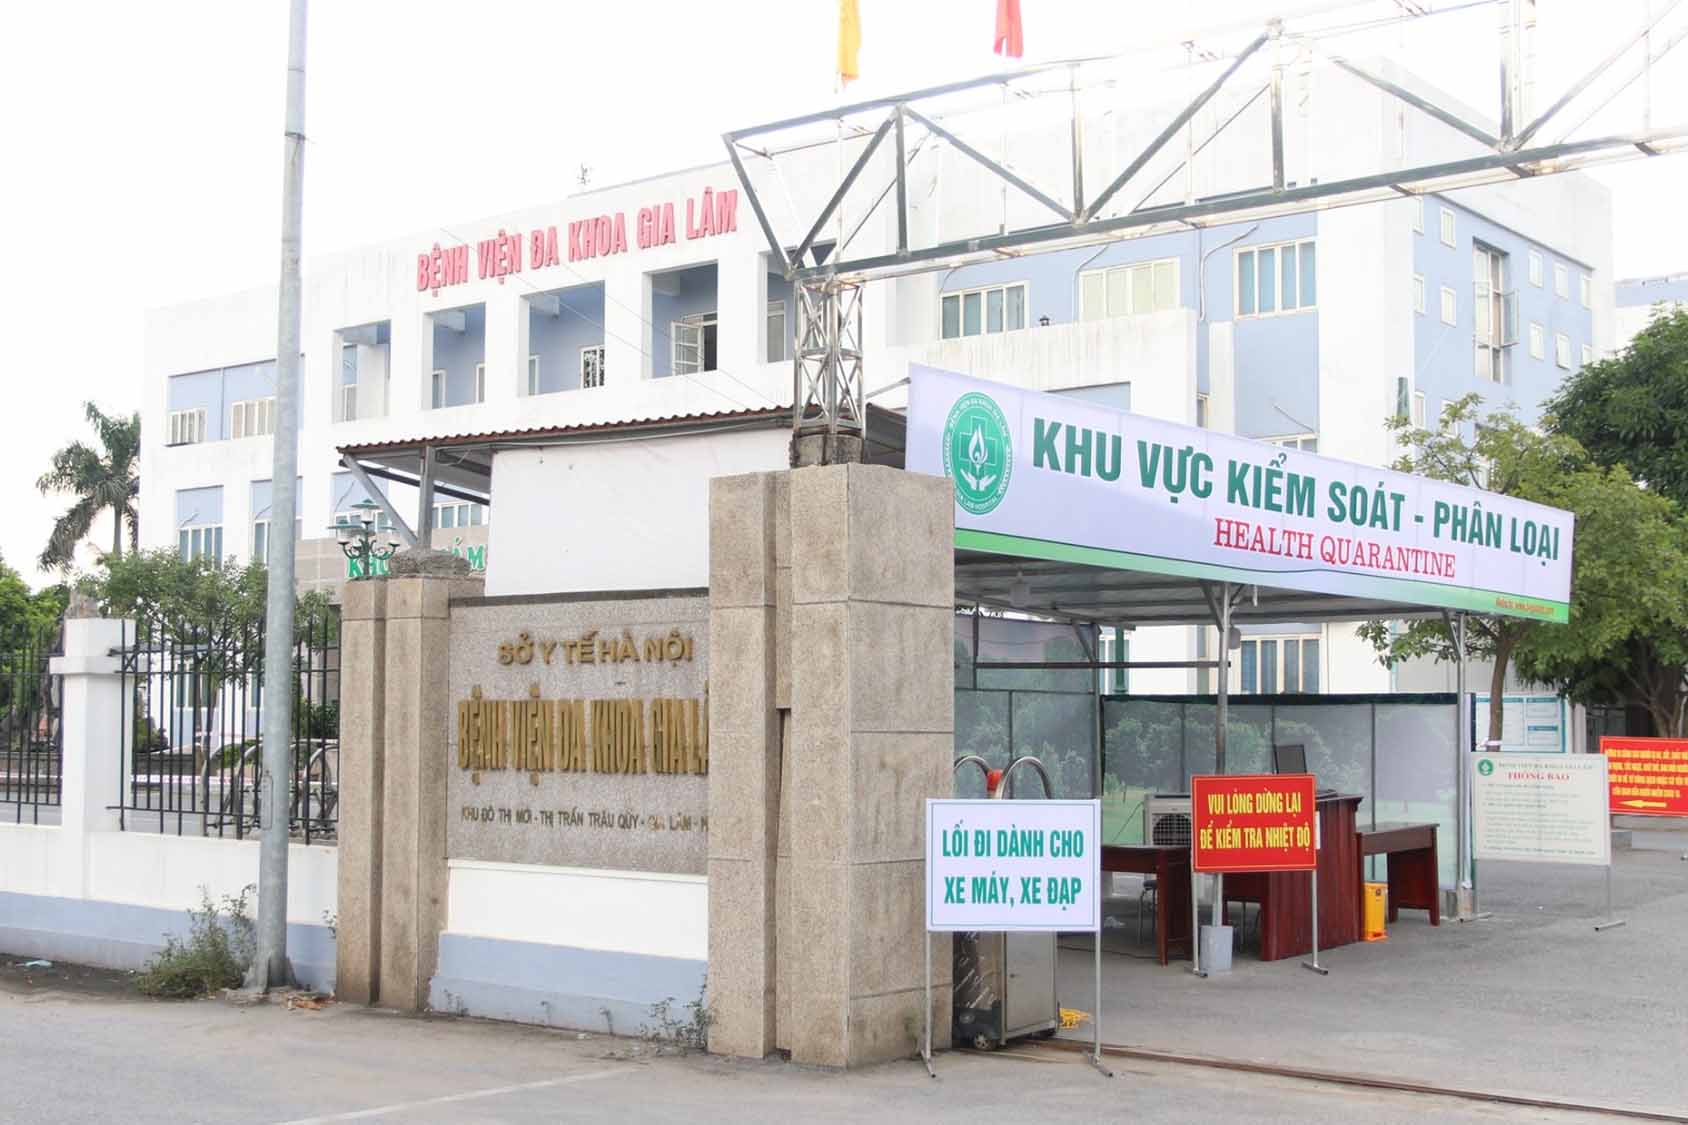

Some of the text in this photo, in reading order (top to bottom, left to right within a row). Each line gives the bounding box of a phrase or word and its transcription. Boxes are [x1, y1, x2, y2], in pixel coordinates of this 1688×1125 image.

[417, 186, 738, 297] BỆNH VIỆN ĐA KHOA GIA LÂM
[1033, 417, 1122, 482] KHU
[1137, 439, 1213, 504] VỰC
[1226, 453, 1315, 518] KIỂM
[1327, 481, 1405, 532] SOÁT
[1414, 514, 1424, 523] -
[1434, 500, 1501, 549] PHÂN
[1510, 516, 1560, 567] LOẠI
[1213, 518, 1456, 578] HEALTH QUARANTINE
[498, 627, 694, 667] SỞ Y TẾ HÀ NỘI
[458, 684, 507, 785] BỆNH
[511, 682, 554, 786] VIỆN
[590, 699, 648, 774] KHOA
[652, 699, 689, 775] GIA
[1208, 787, 1301, 818] VUI LÒNG DỪNG LẠI
[942, 819, 1084, 858] LỐI ĐI DÀNH CHO
[1200, 819, 1310, 853] ĐỂ KIỂM TRA NHIỆT ĐỘ
[944, 871, 1082, 911] XE MÁY, XE ĐẠP
